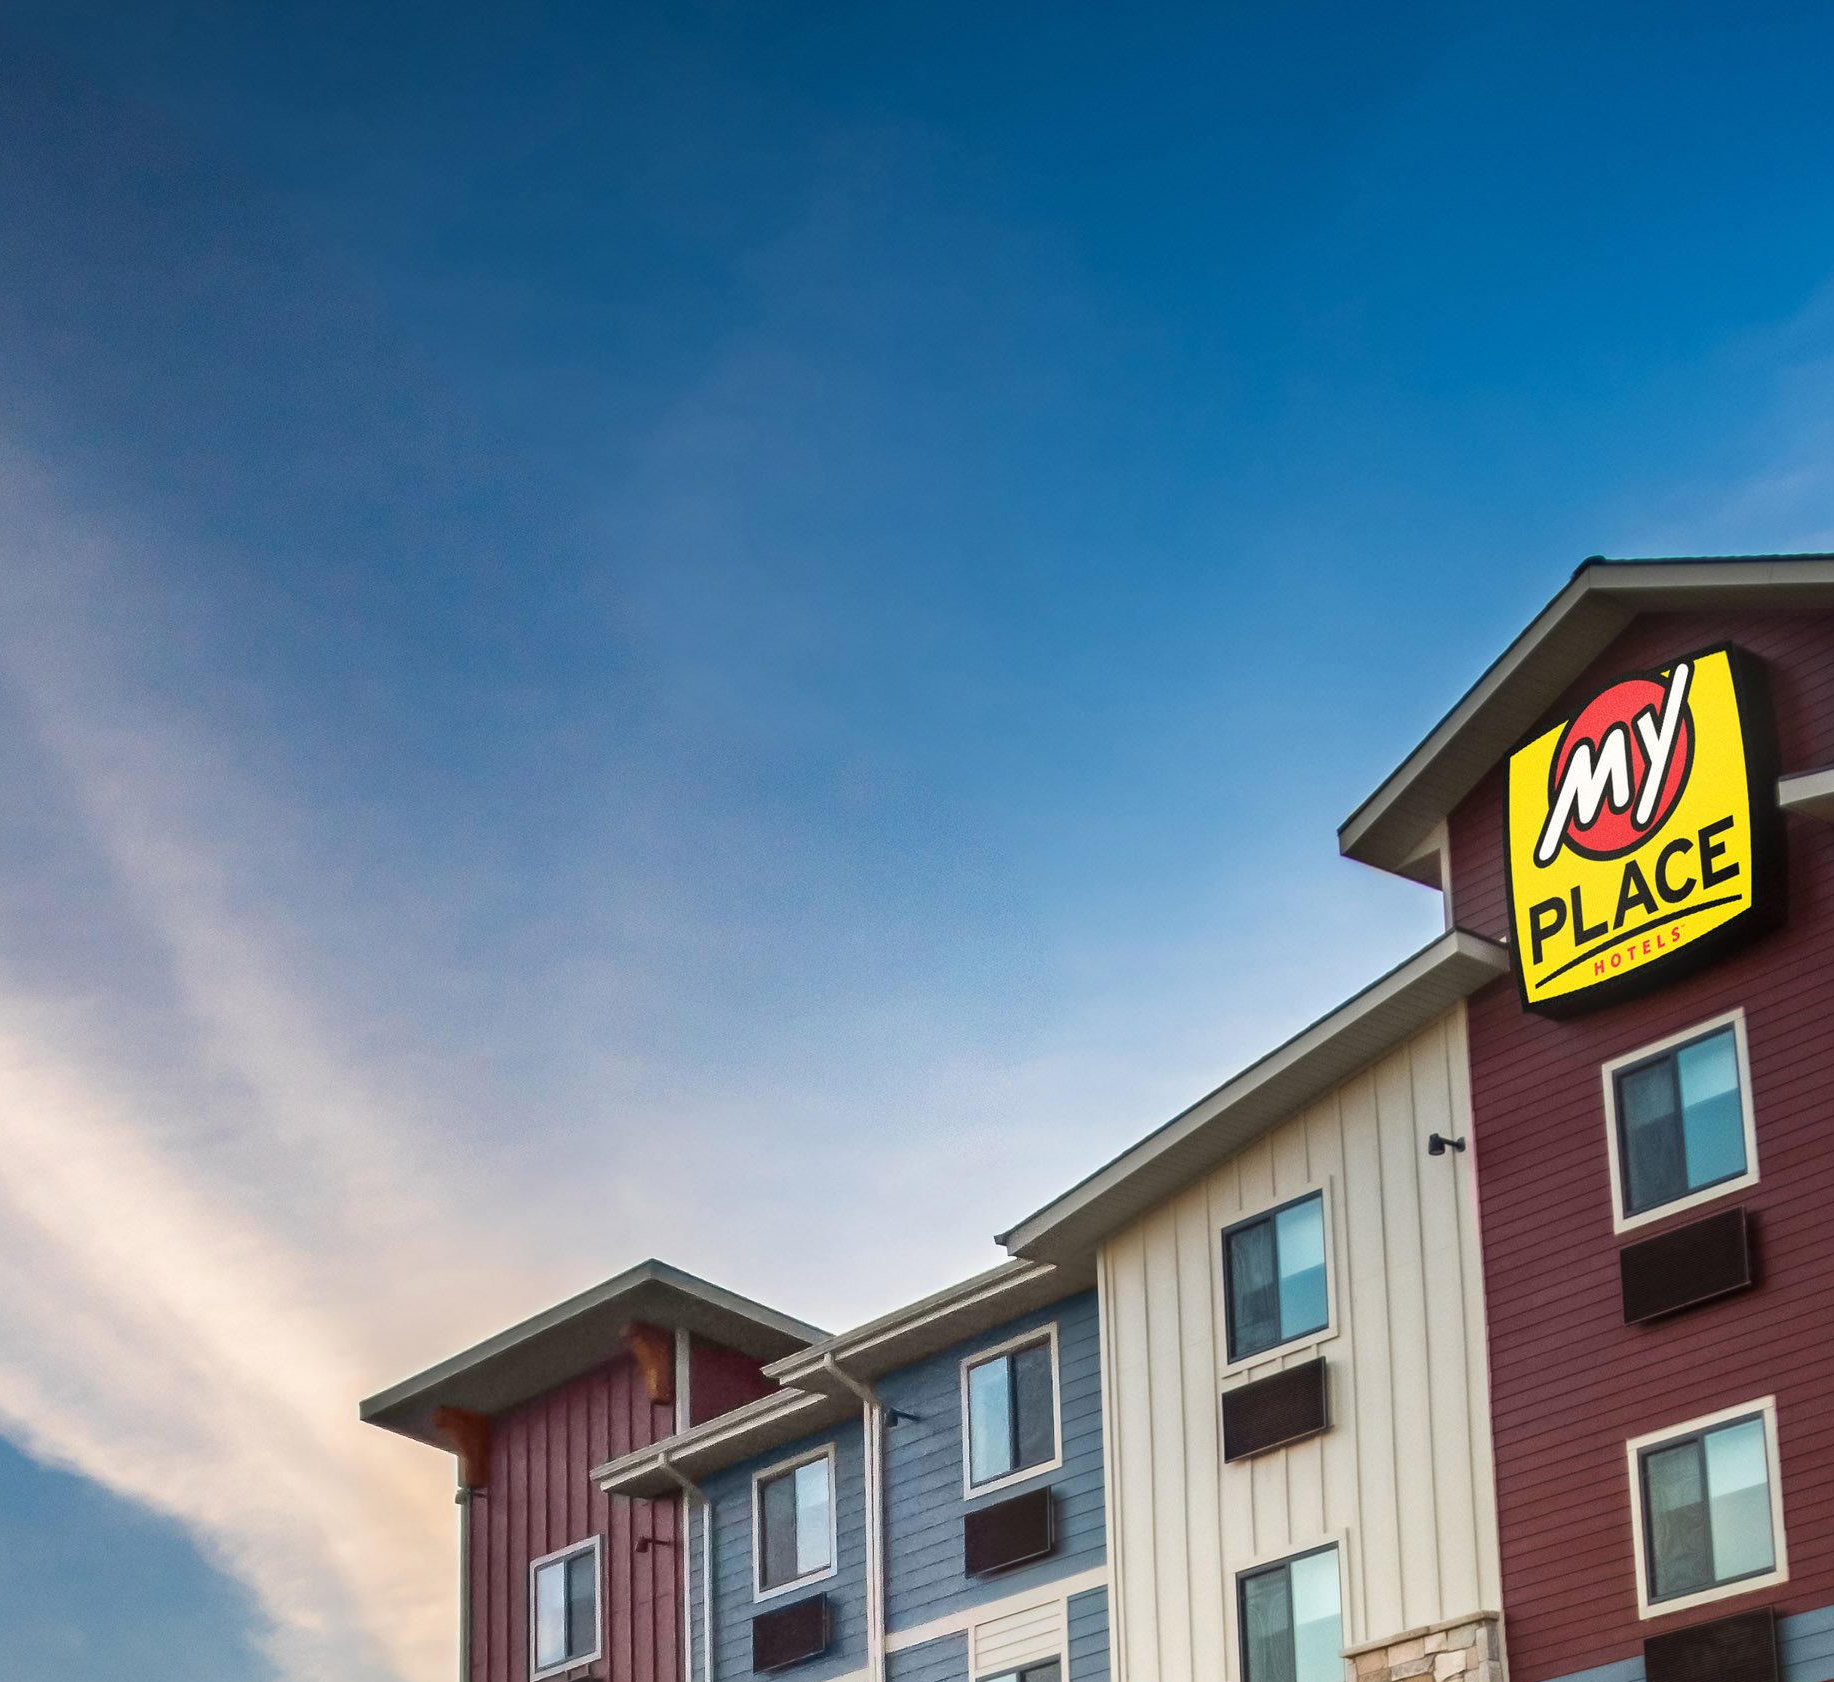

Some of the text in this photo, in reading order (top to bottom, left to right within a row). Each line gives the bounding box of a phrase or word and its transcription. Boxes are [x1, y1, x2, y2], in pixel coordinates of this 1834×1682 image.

[1538, 662, 1690, 862] MY
[1528, 814, 1741, 966] PLACE
[1593, 925, 1682, 977] HOTELS
